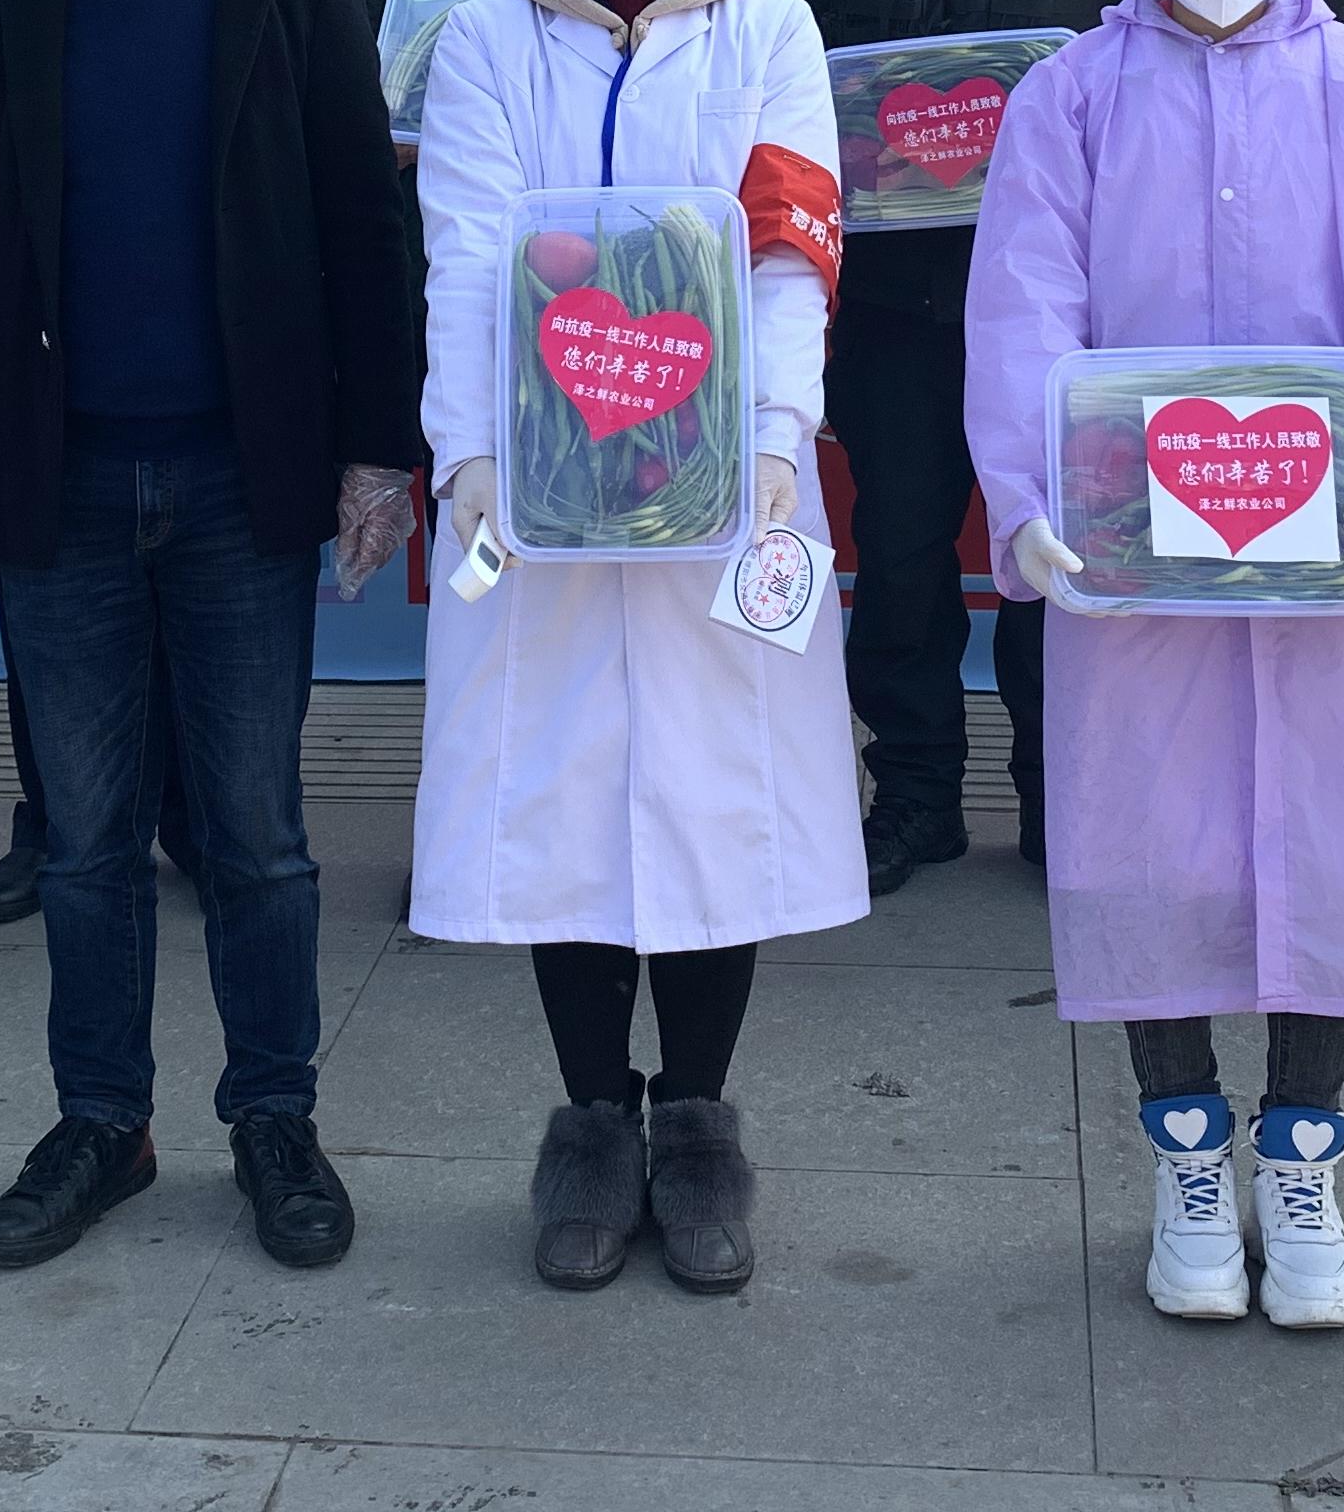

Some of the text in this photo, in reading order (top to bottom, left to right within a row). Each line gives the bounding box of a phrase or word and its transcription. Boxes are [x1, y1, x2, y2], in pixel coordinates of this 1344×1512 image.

[550, 314, 705, 361] 向抗疫一线工作人员致敬
[1157, 431, 1322, 451] 向抗疫一线工作人员致敬
